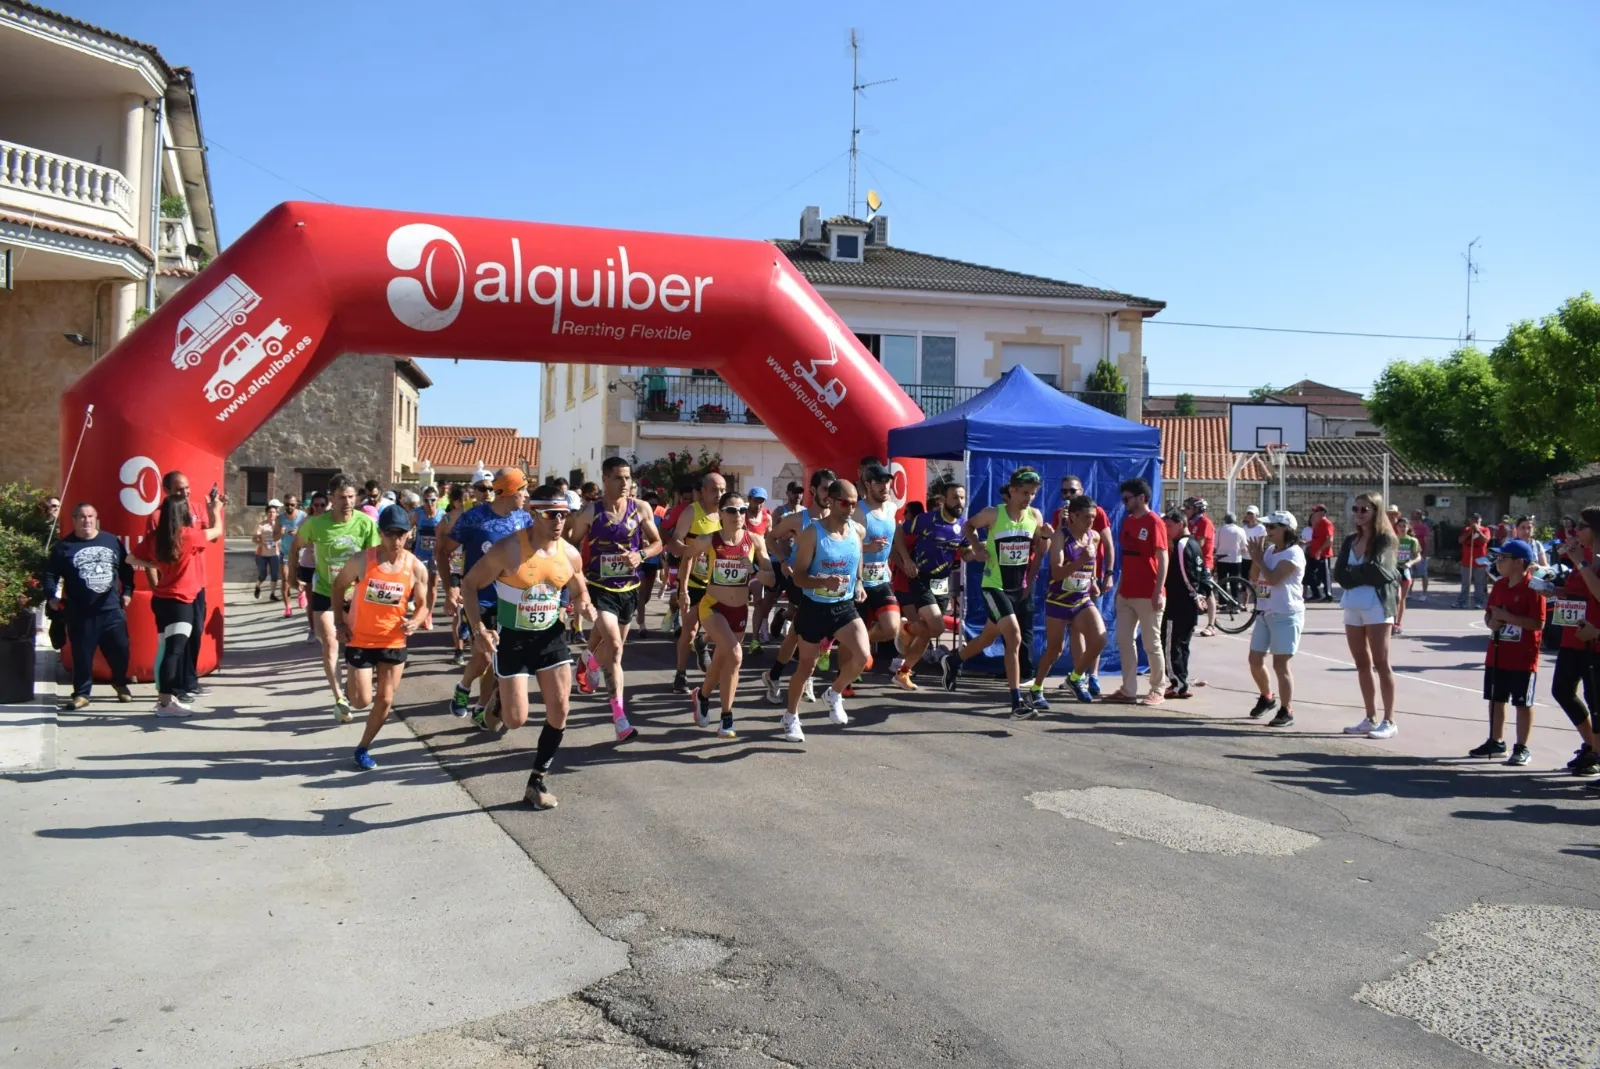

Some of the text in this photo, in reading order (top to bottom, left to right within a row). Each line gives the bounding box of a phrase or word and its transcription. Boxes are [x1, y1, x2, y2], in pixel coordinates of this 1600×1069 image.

[473, 237, 714, 334] alquiber
[561, 320, 692, 341] Renting Flexible
[216, 335, 313, 422] www.alquiber.es
[766, 355, 838, 434] www.alquiber.es
[1009, 550, 1022, 560] 32
[610, 562, 624, 571] 97
[724, 568, 738, 579] 90
[868, 569, 879, 577] 95
[377, 590, 392, 600] 84
[529, 611, 546, 623] 53
[1560, 609, 1578, 620] 131
